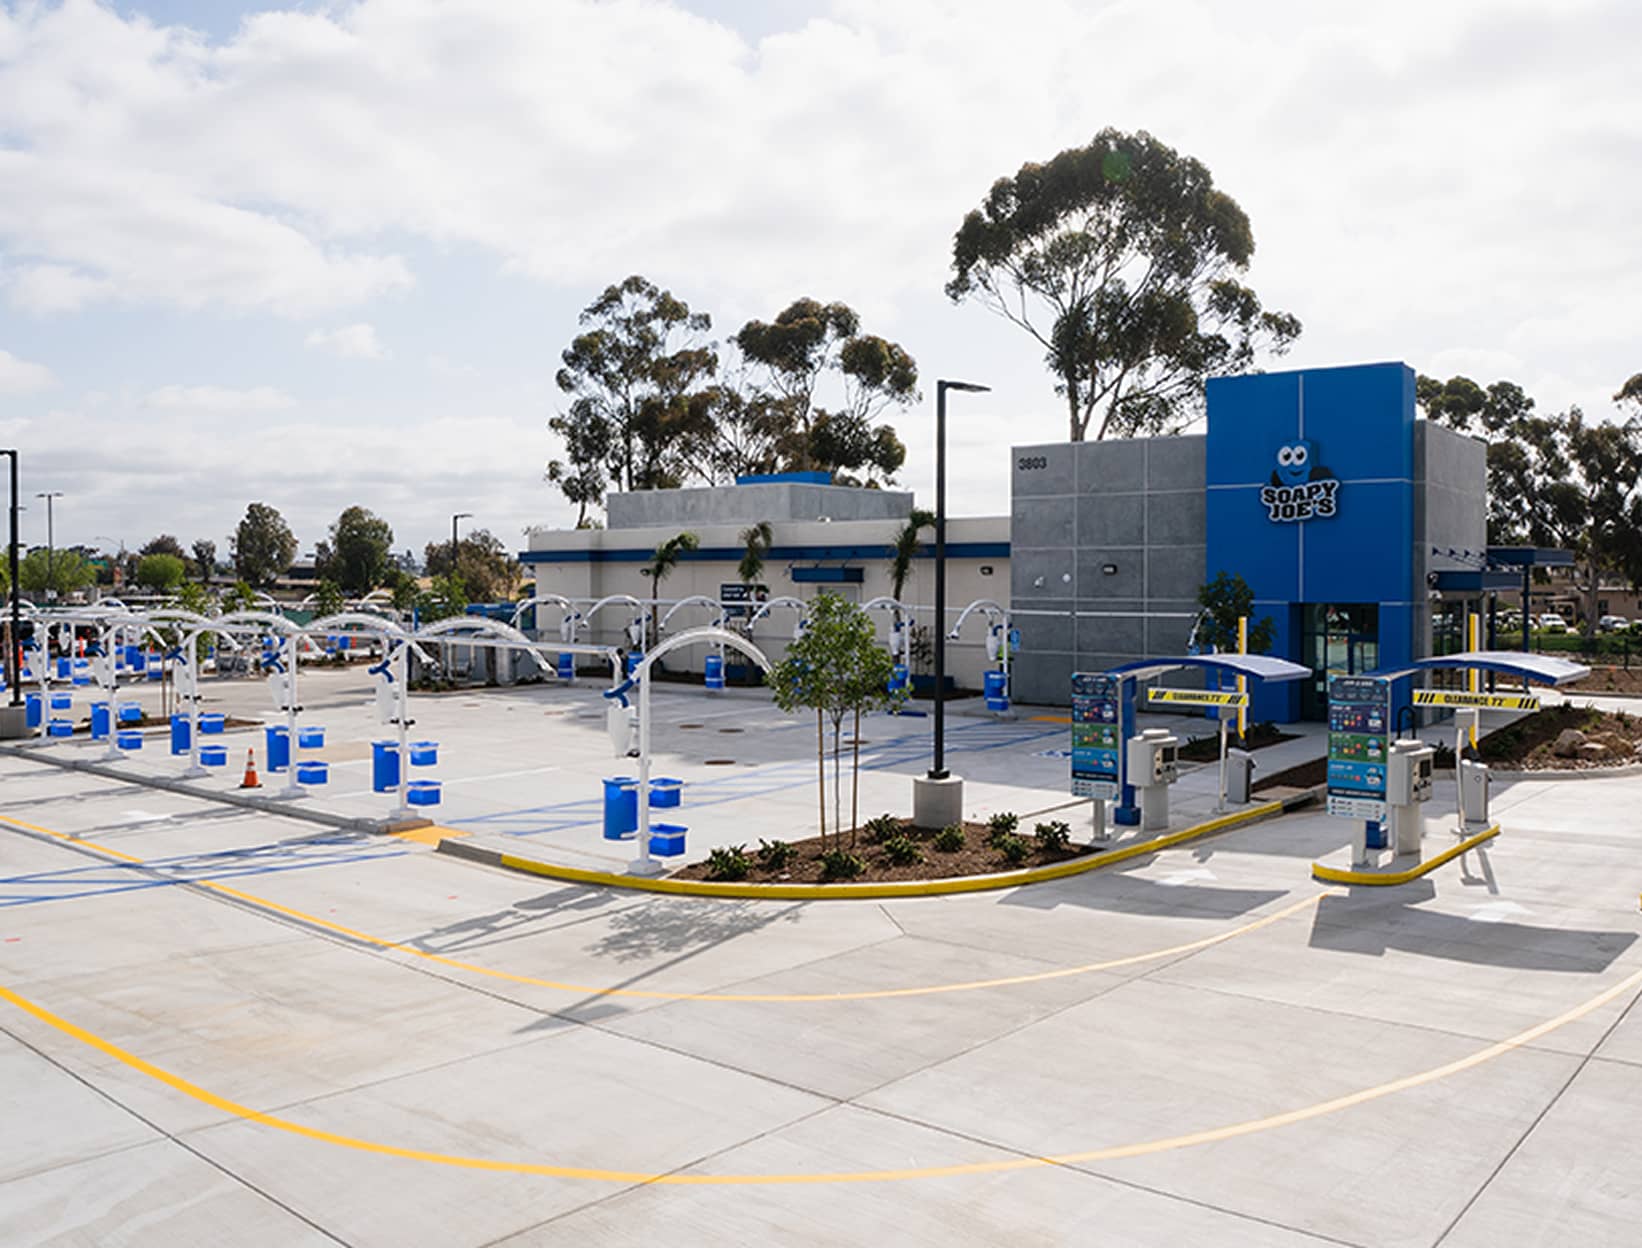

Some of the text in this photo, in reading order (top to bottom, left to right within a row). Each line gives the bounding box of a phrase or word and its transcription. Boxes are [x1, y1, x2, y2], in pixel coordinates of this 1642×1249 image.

[1018, 456, 1047, 470] 3803
[1262, 481, 1338, 504] SOAPY
[1270, 498, 1335, 519] JOE'S
[1443, 693, 1489, 706] CLEARANCE
